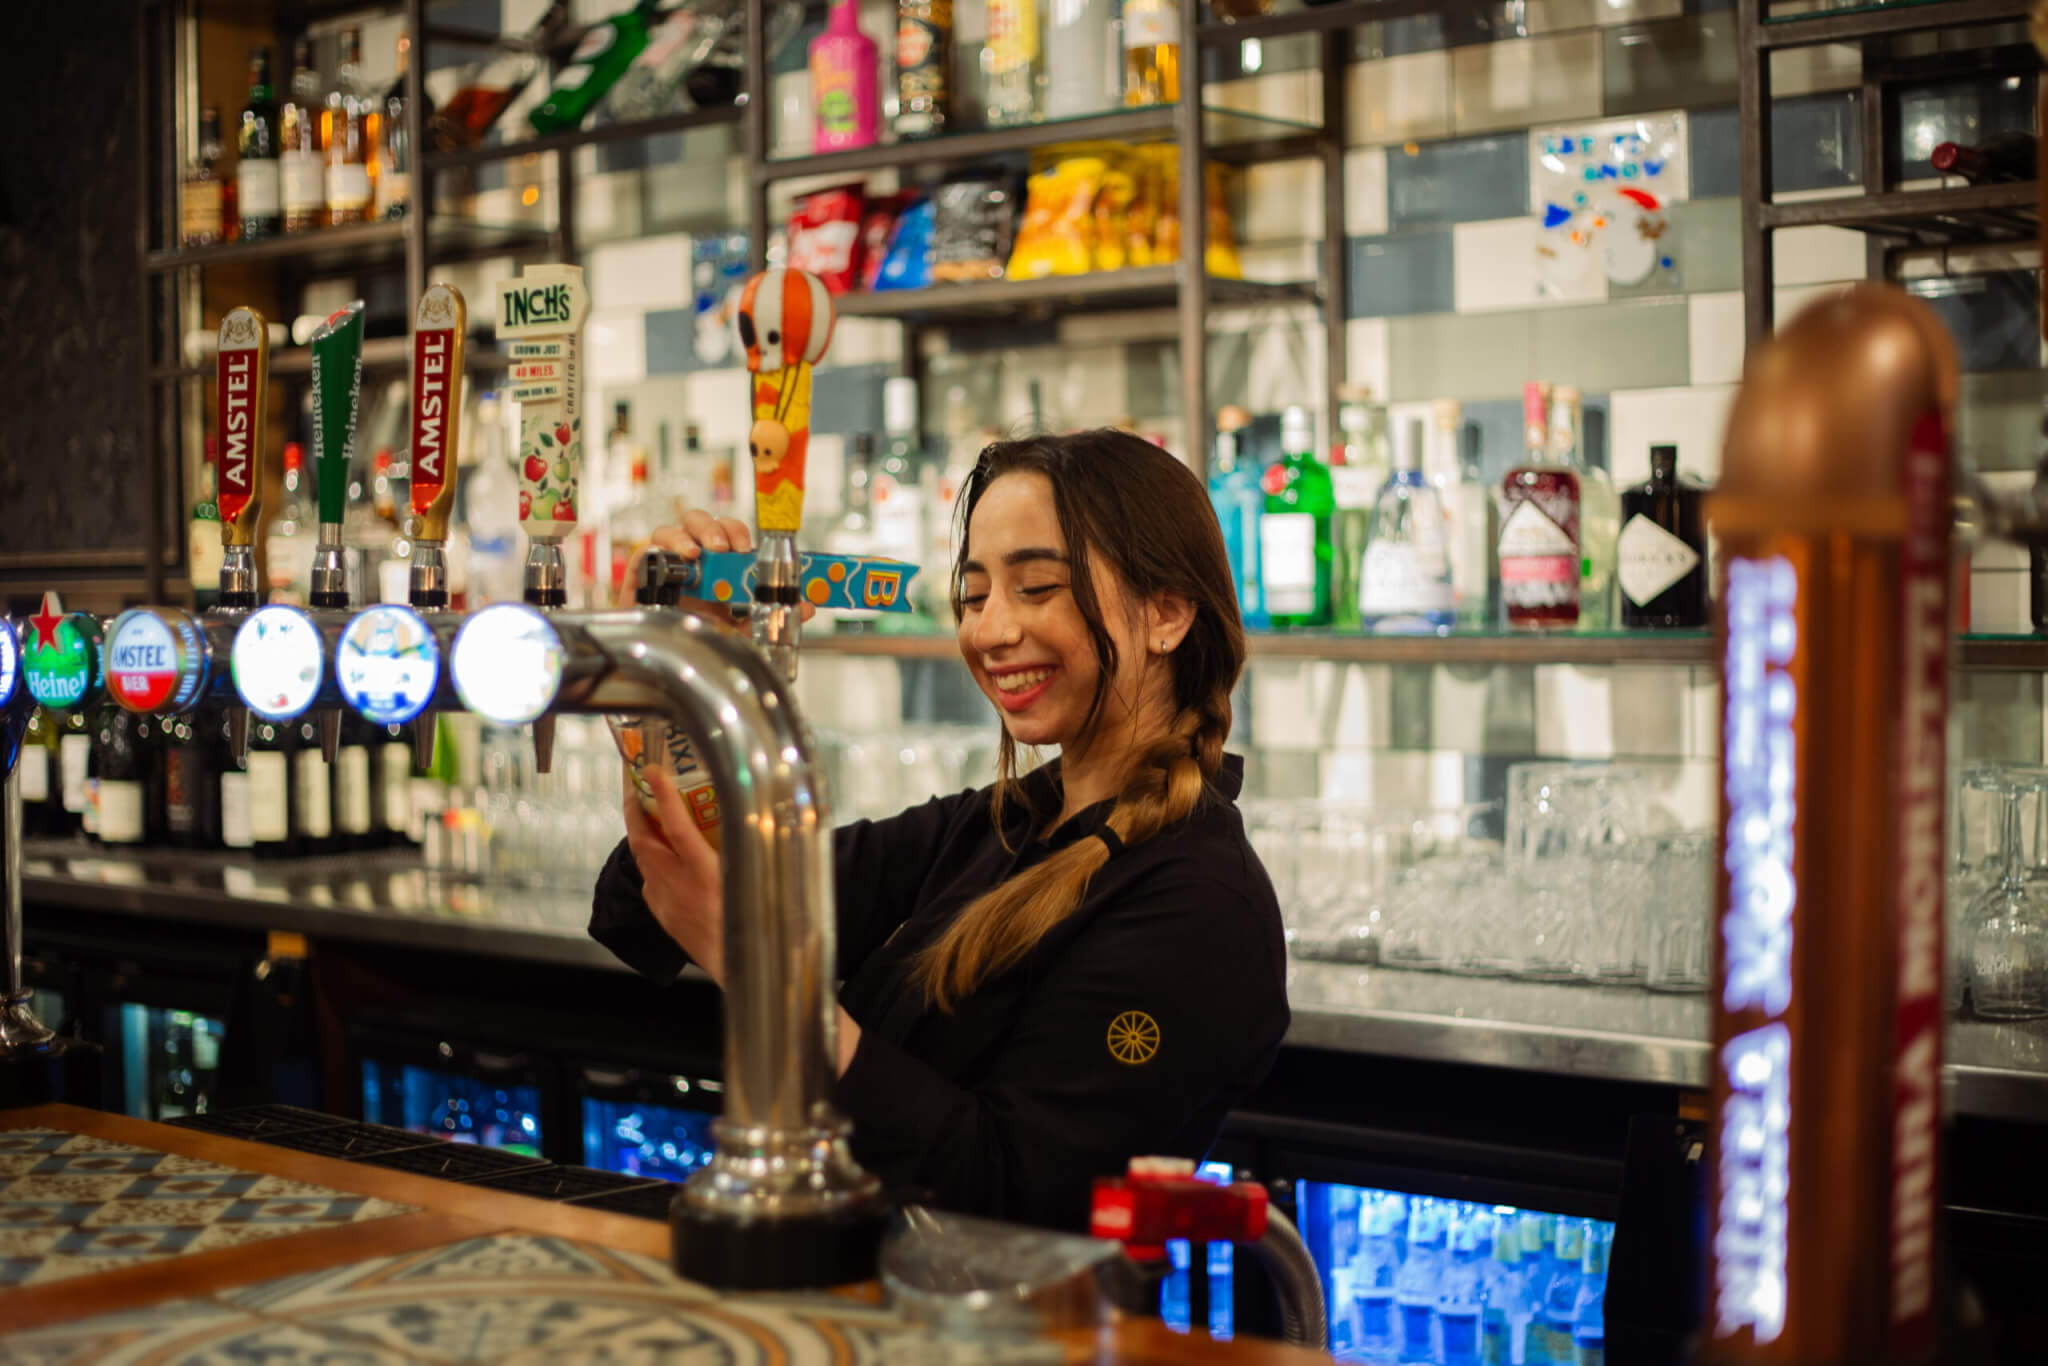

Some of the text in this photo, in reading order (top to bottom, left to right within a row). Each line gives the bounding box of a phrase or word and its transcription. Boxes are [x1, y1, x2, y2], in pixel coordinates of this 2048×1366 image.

[225, 354, 249, 487] AMSTEL
[342, 355, 363, 460] Heineken
[419, 335, 445, 478] AMSTEL
[528, 364, 555, 377] MILES
[112, 644, 167, 668] AMSTEL
